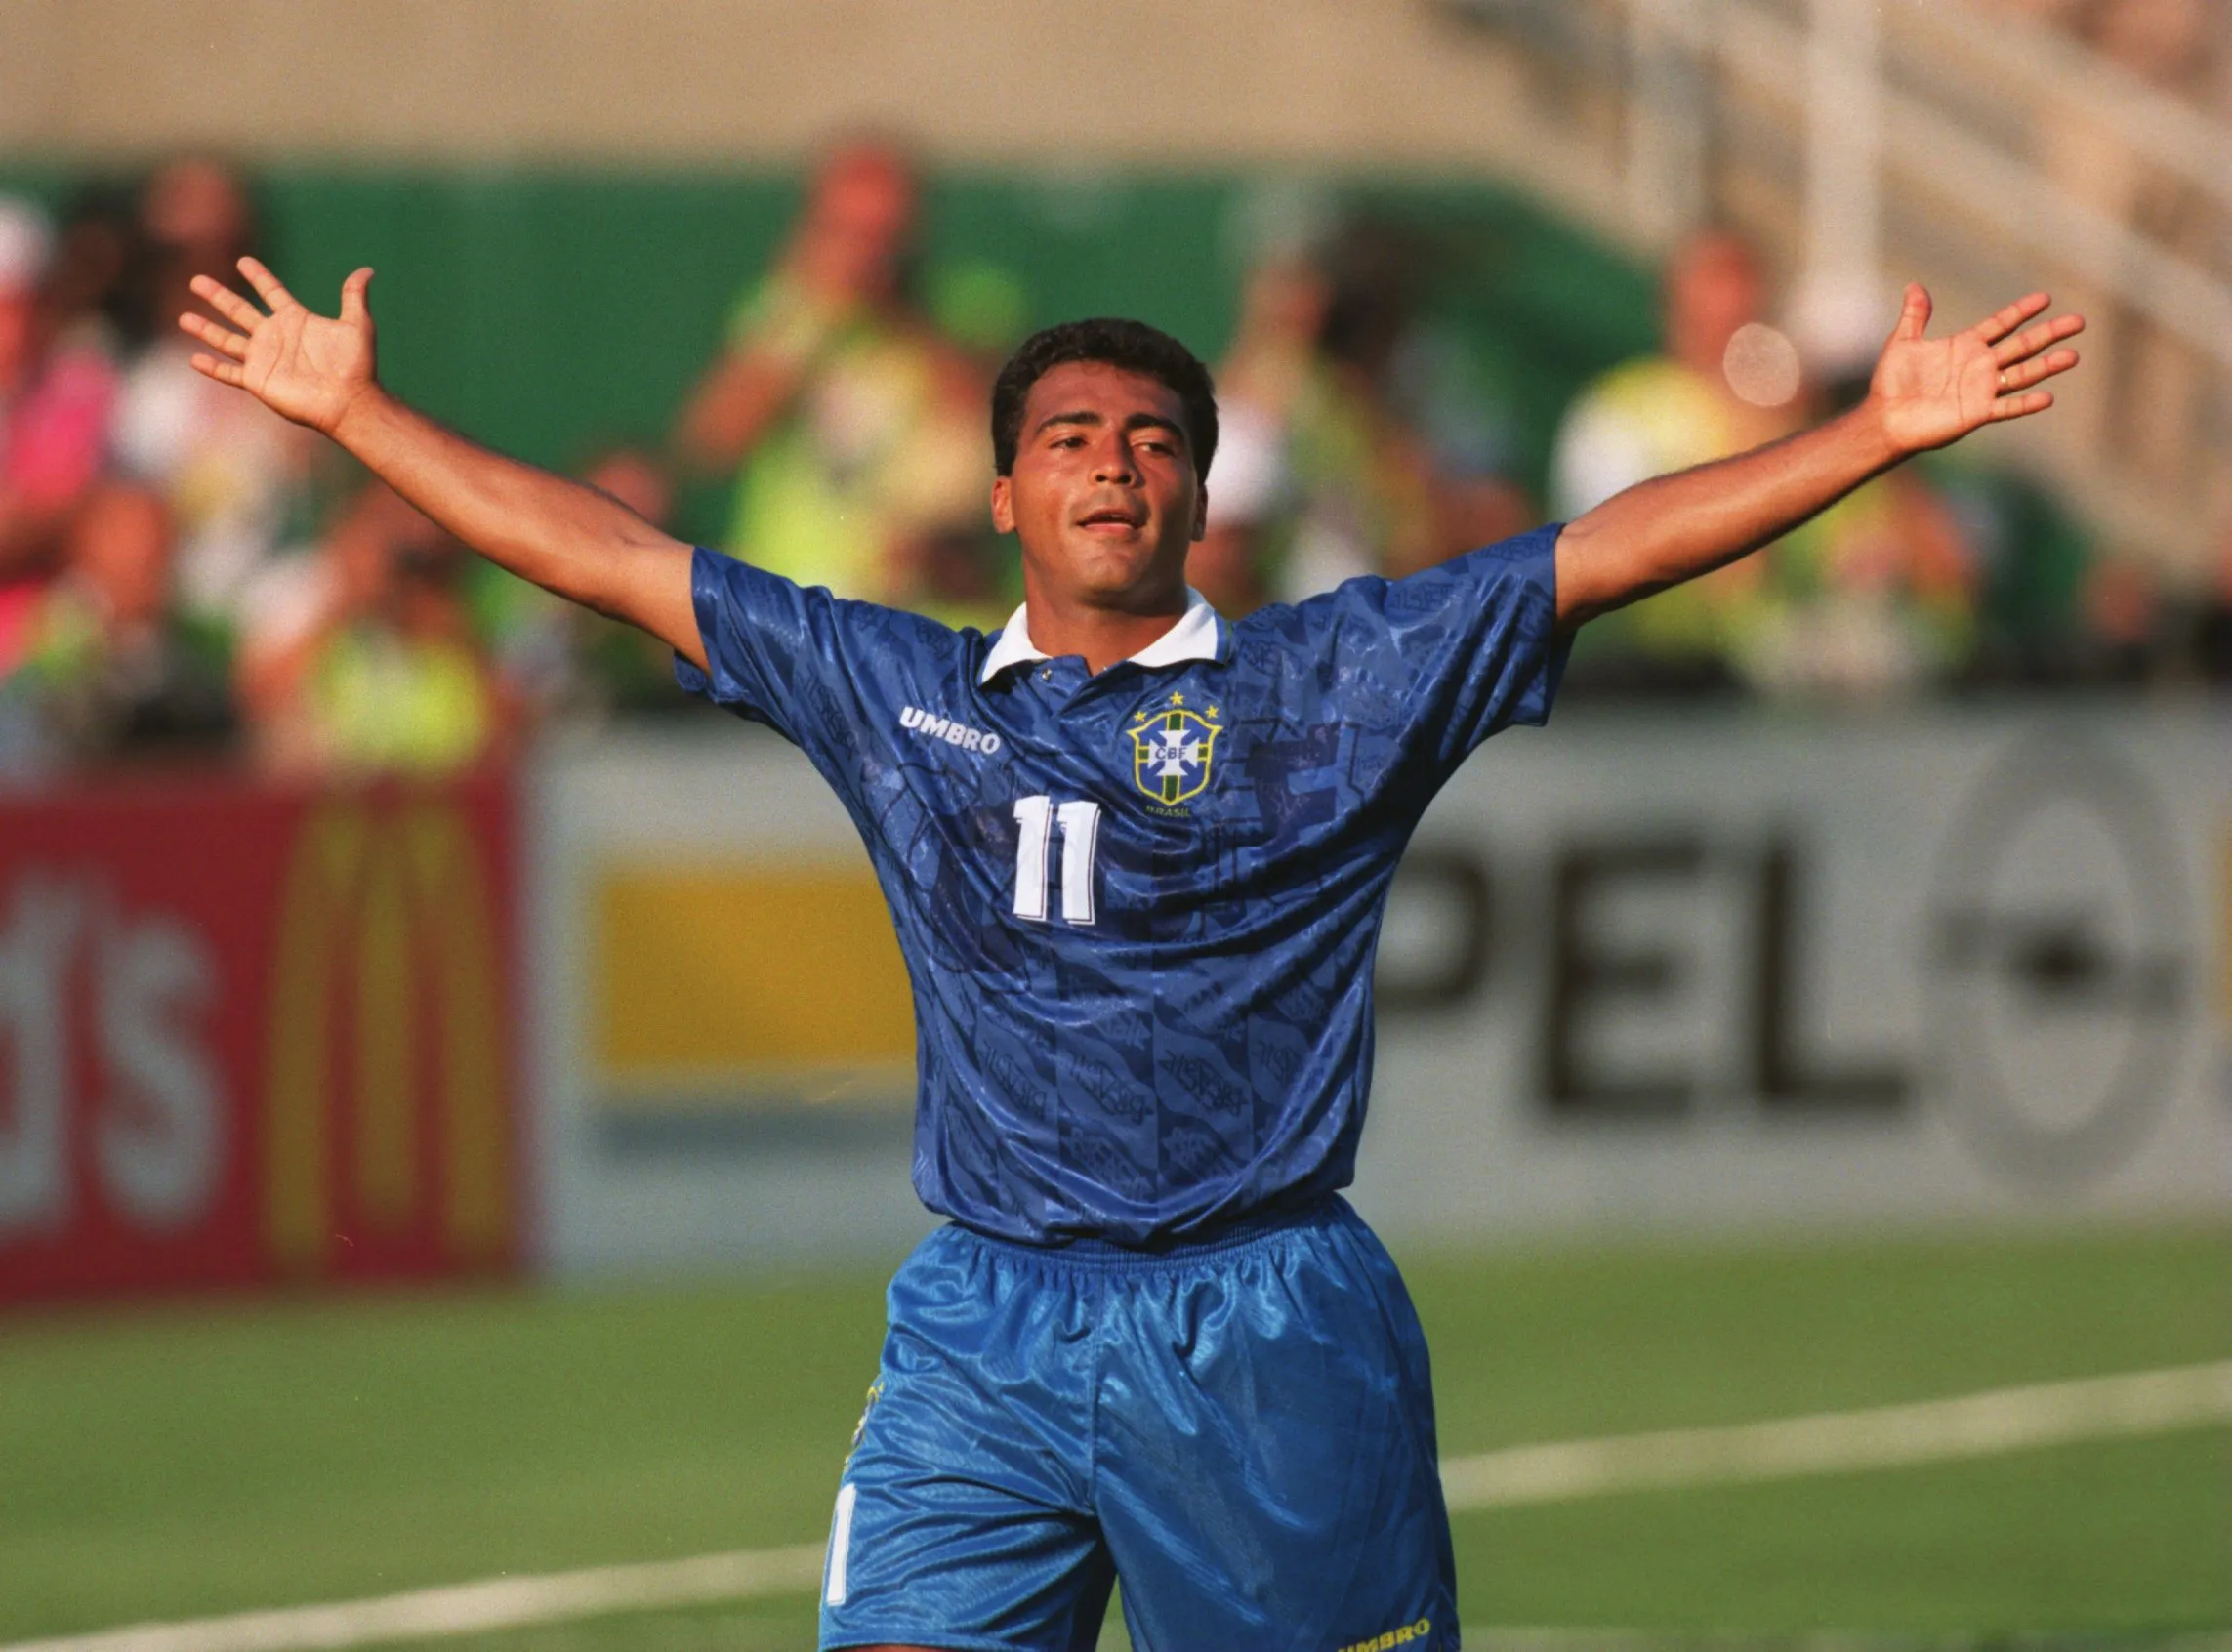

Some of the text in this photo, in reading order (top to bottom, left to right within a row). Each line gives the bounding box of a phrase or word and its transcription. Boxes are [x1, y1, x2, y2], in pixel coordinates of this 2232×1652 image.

[899, 706, 1001, 756] UMBRO
[1155, 747, 1187, 760] CBF
[1013, 795, 1102, 925] 11
